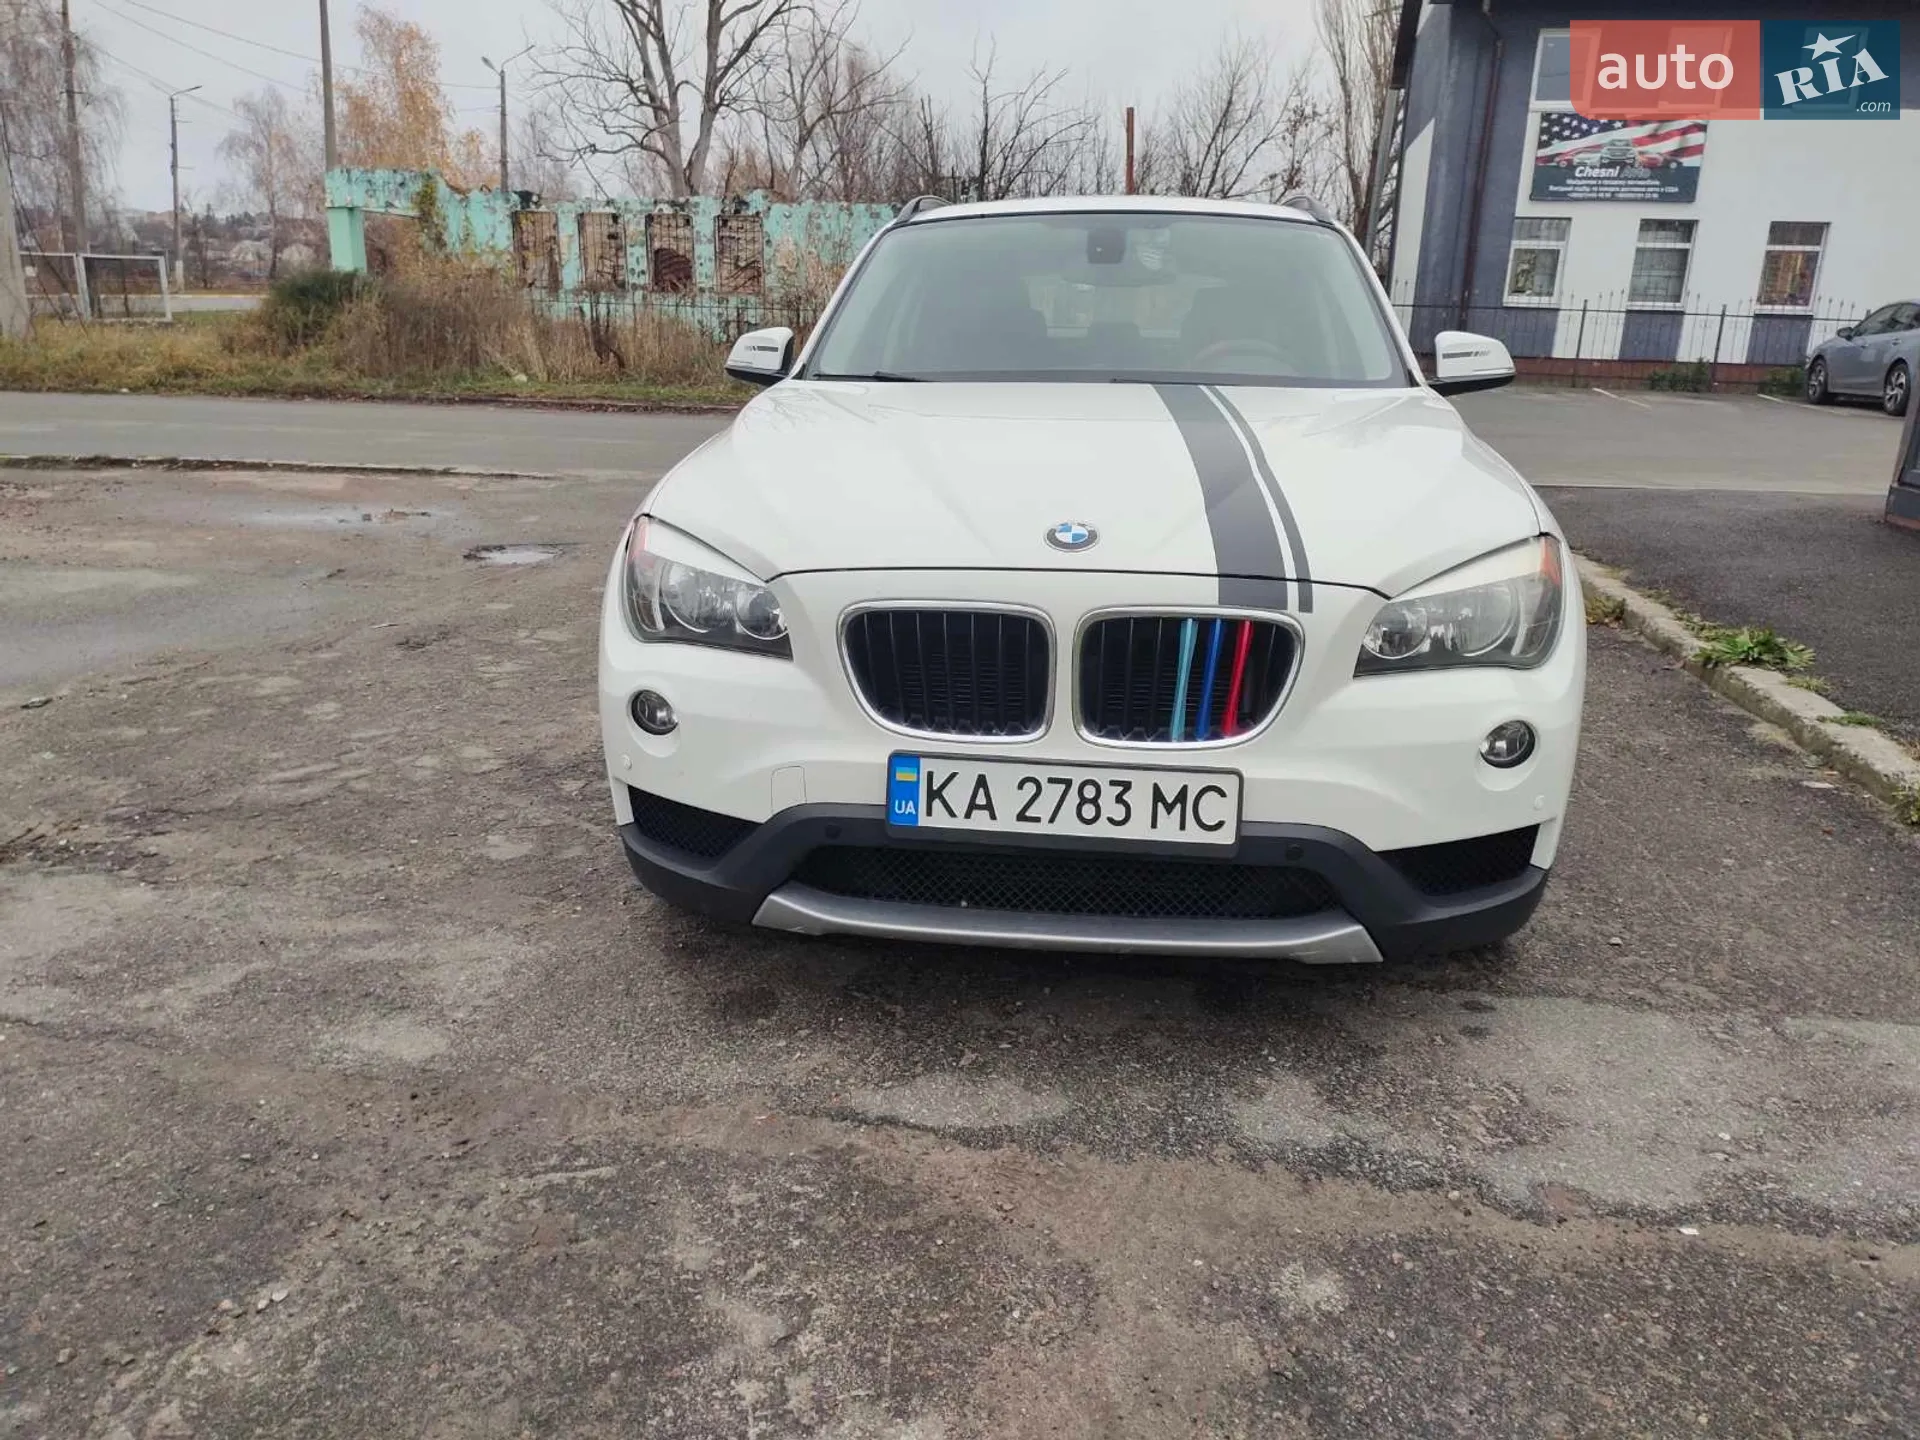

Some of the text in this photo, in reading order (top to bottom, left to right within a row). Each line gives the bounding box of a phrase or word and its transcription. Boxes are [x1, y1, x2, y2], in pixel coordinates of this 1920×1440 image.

[1575, 165, 1620, 177] Chesni
[895, 801, 916, 815] UA
[926, 771, 1228, 832] KA 2783 MC
